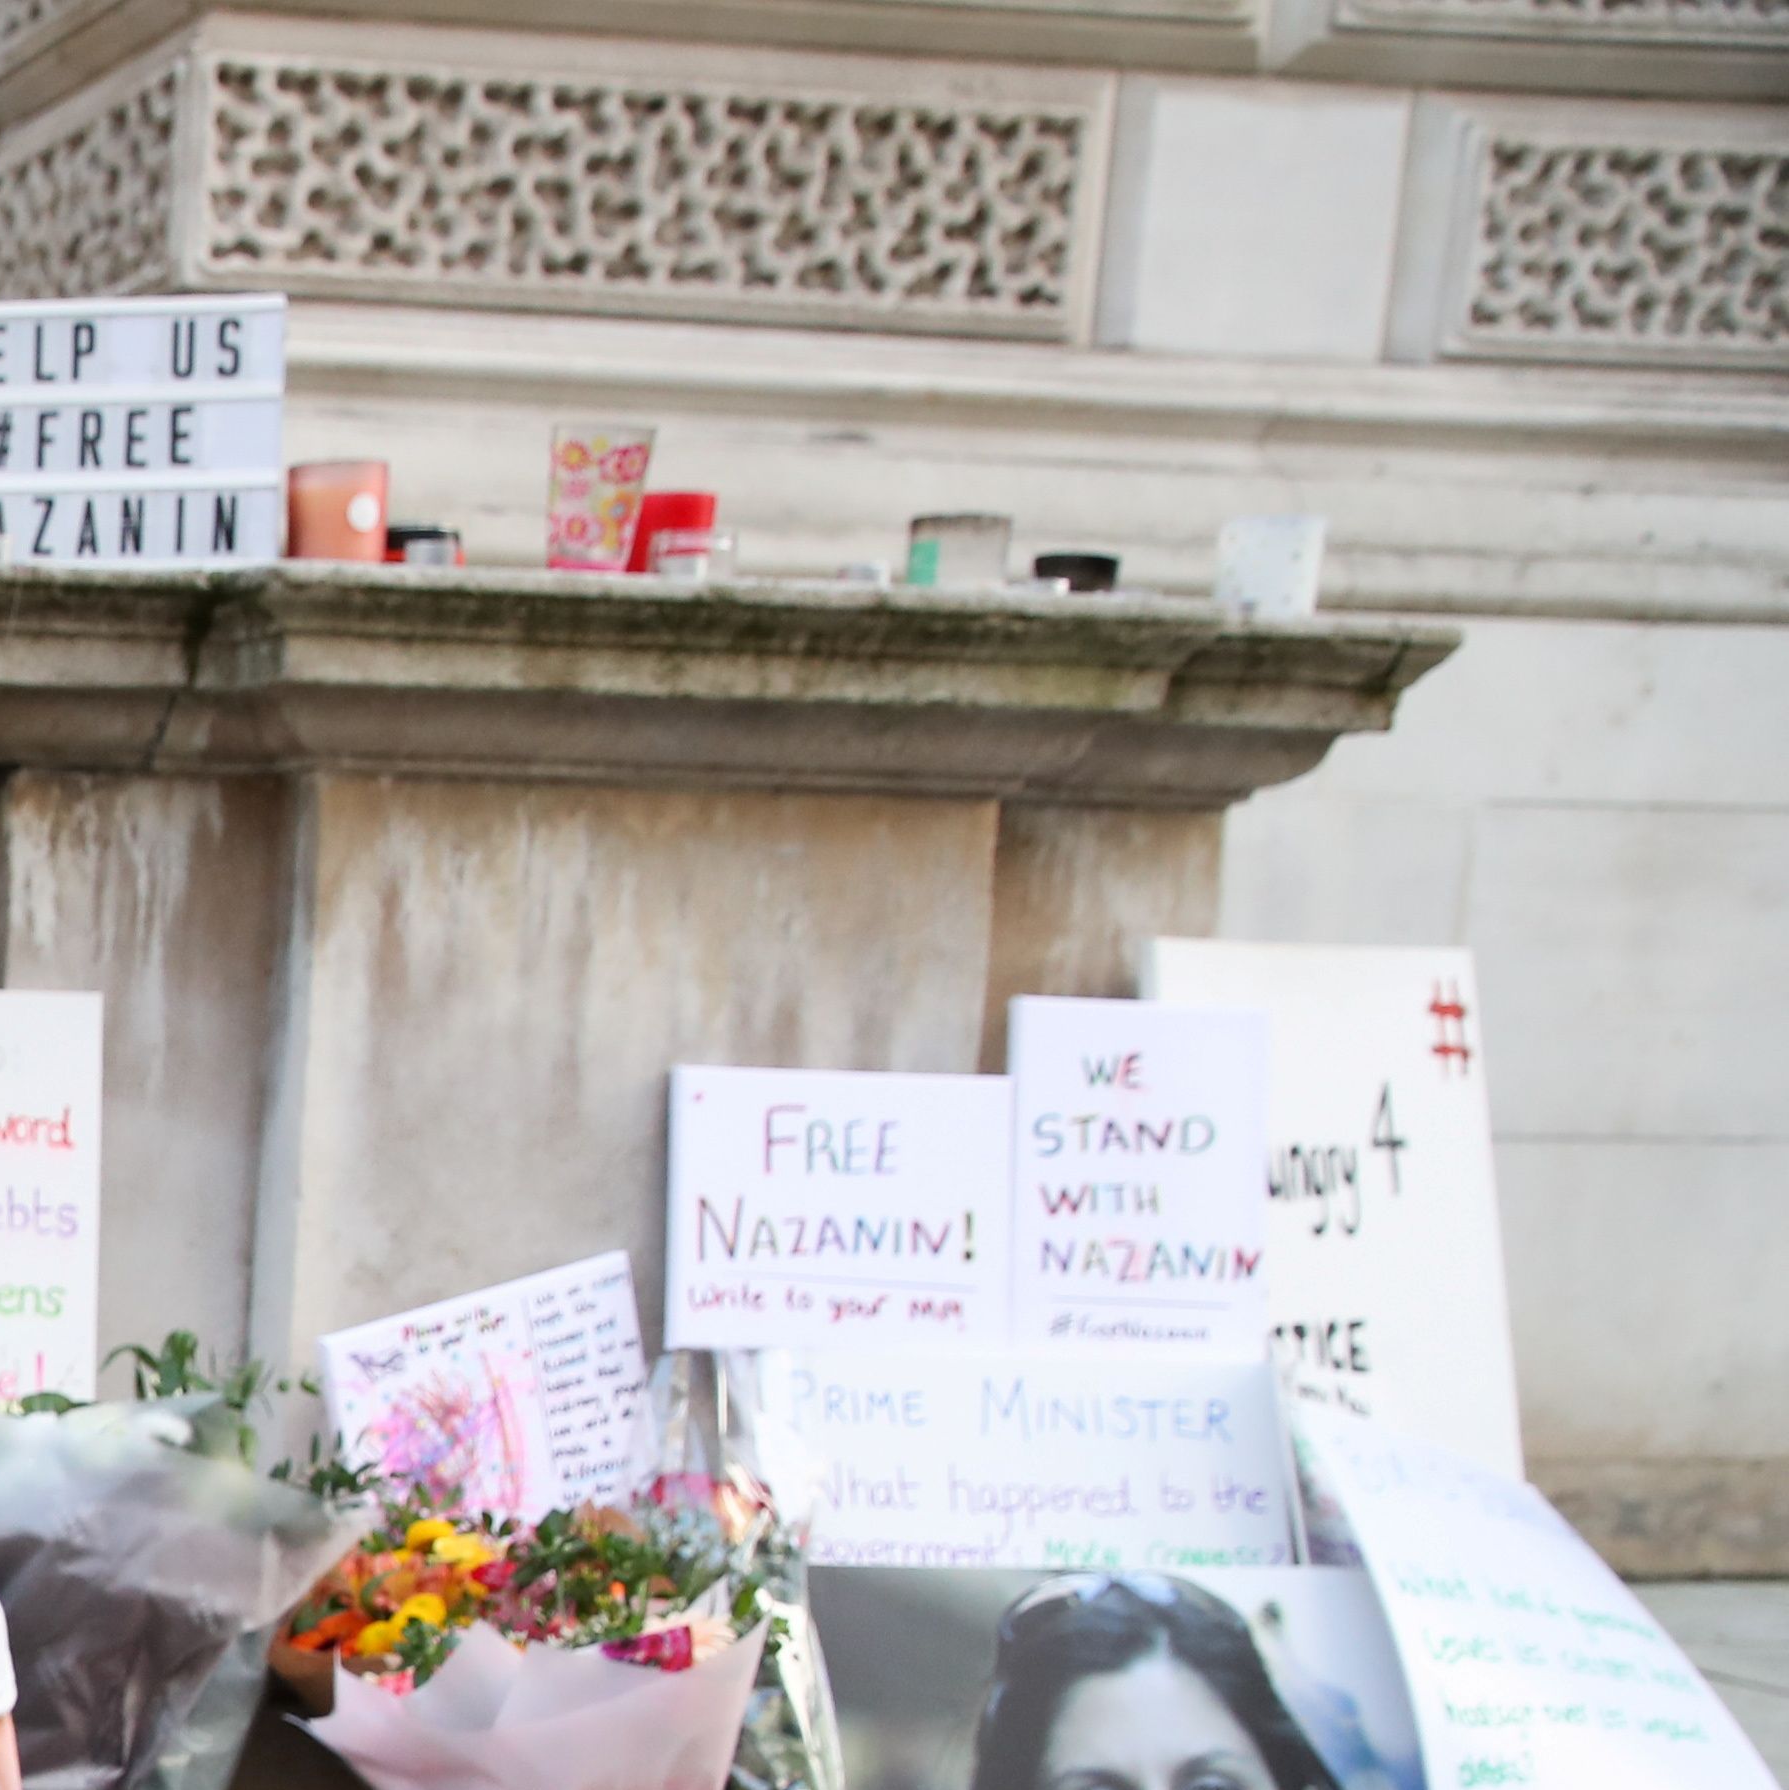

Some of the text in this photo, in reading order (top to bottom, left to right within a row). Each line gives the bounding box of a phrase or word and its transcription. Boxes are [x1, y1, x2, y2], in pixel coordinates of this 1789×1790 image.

[173, 317, 241, 379] US
[1082, 1051, 1145, 1090] WE
[1032, 1113, 1216, 1158] STAND
[1039, 1183, 1162, 1216] WITH
[1268, 1143, 1361, 1236] ungry
[1039, 1238, 1263, 1284] NAZANIN
[979, 1377, 1235, 1443] MINISTER
[946, 1465, 1140, 1539] happened
[1159, 1467, 1196, 1513] to
[1213, 1464, 1269, 1514] the
